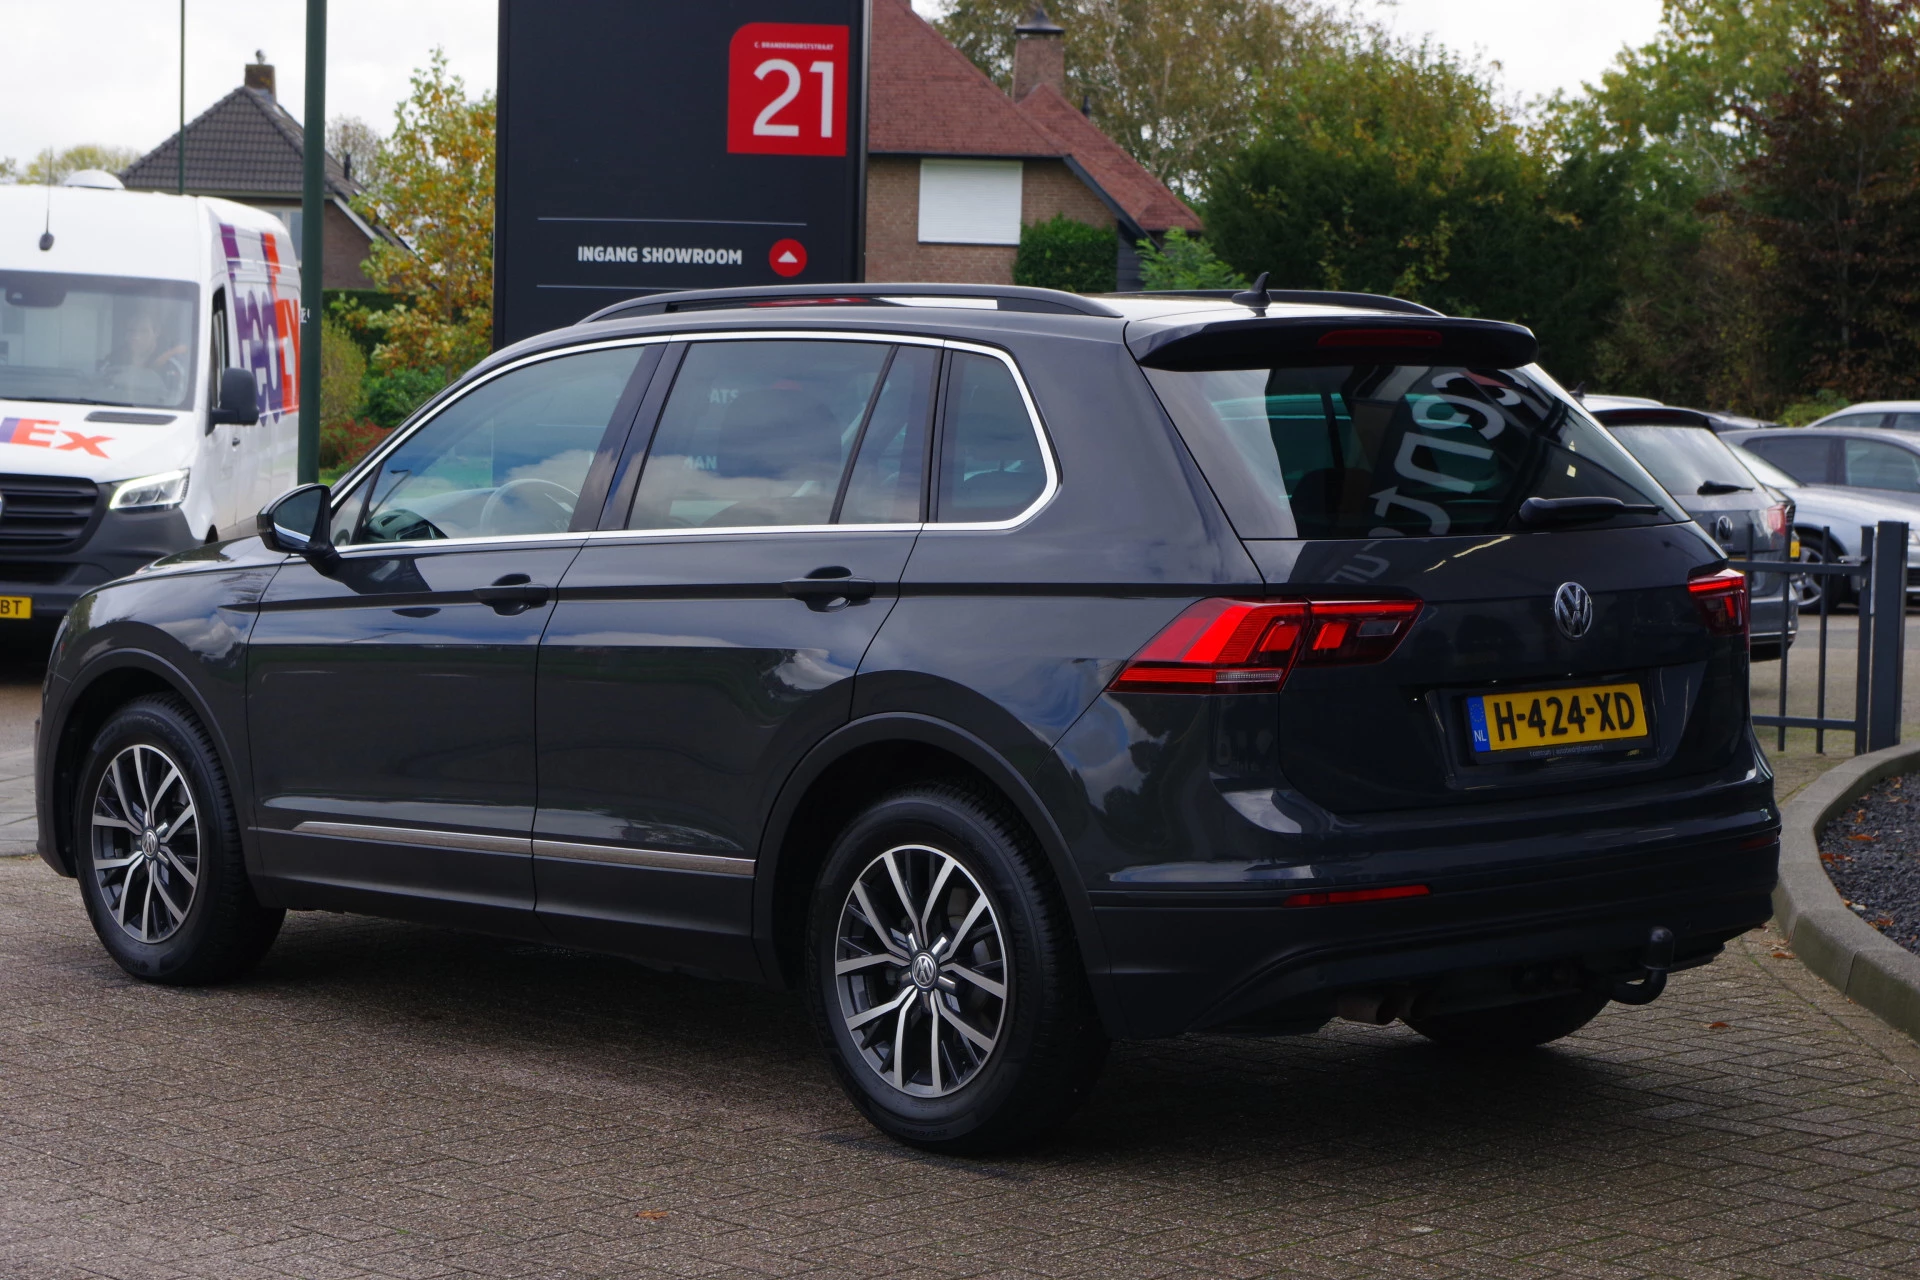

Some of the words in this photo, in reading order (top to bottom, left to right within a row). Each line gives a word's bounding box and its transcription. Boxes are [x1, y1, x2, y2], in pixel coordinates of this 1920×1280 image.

[753, 58, 834, 138] 21
[577, 246, 638, 262] INGANG
[642, 247, 743, 265] SHOWROOM
[0, 599, 23, 615] BT
[1473, 730, 1487, 742] NL
[1493, 691, 1635, 742] H-424-XD
